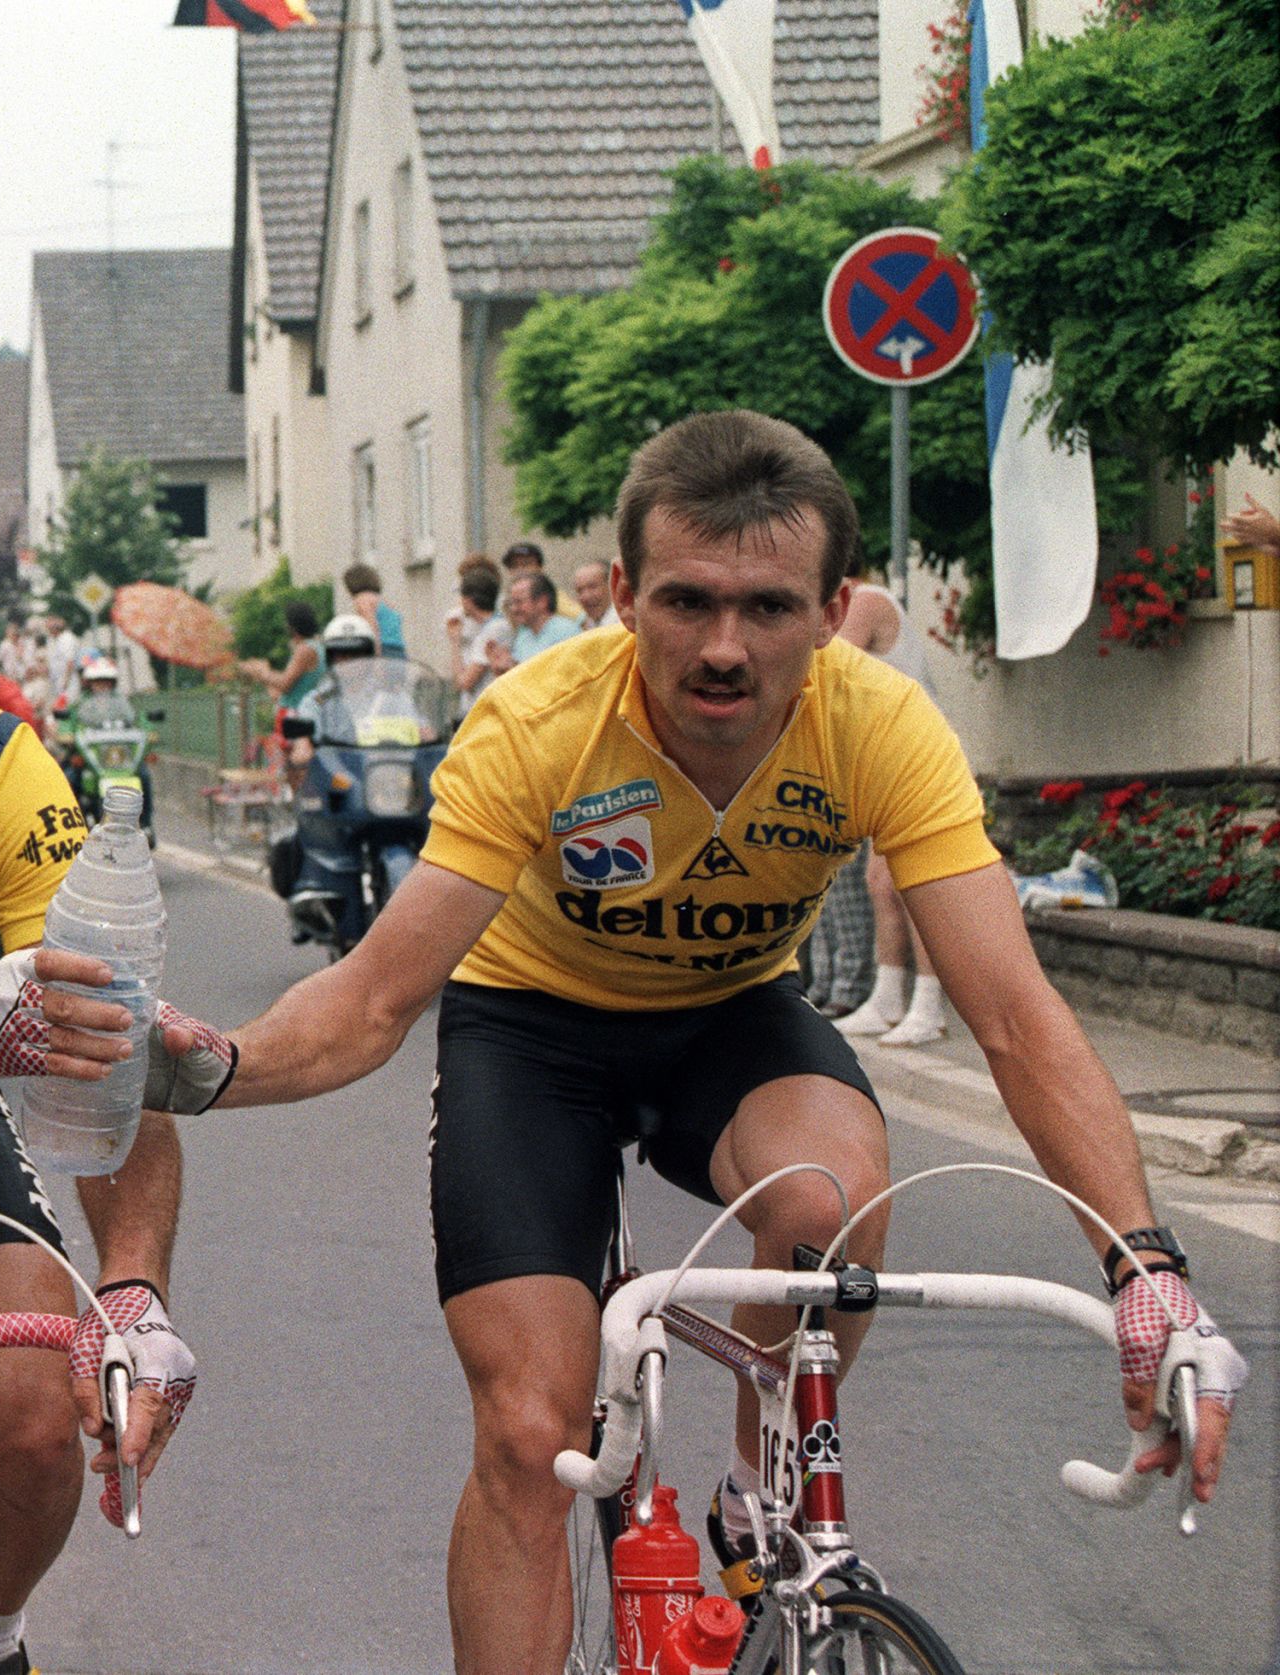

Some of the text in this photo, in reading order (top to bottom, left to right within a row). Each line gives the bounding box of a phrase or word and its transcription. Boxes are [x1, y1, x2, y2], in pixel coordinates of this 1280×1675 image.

[36, 804, 85, 838] Fas
[570, 788, 656, 823] Parisien
[567, 874, 593, 886] TOUR
[610, 871, 648, 885] FRANCE
